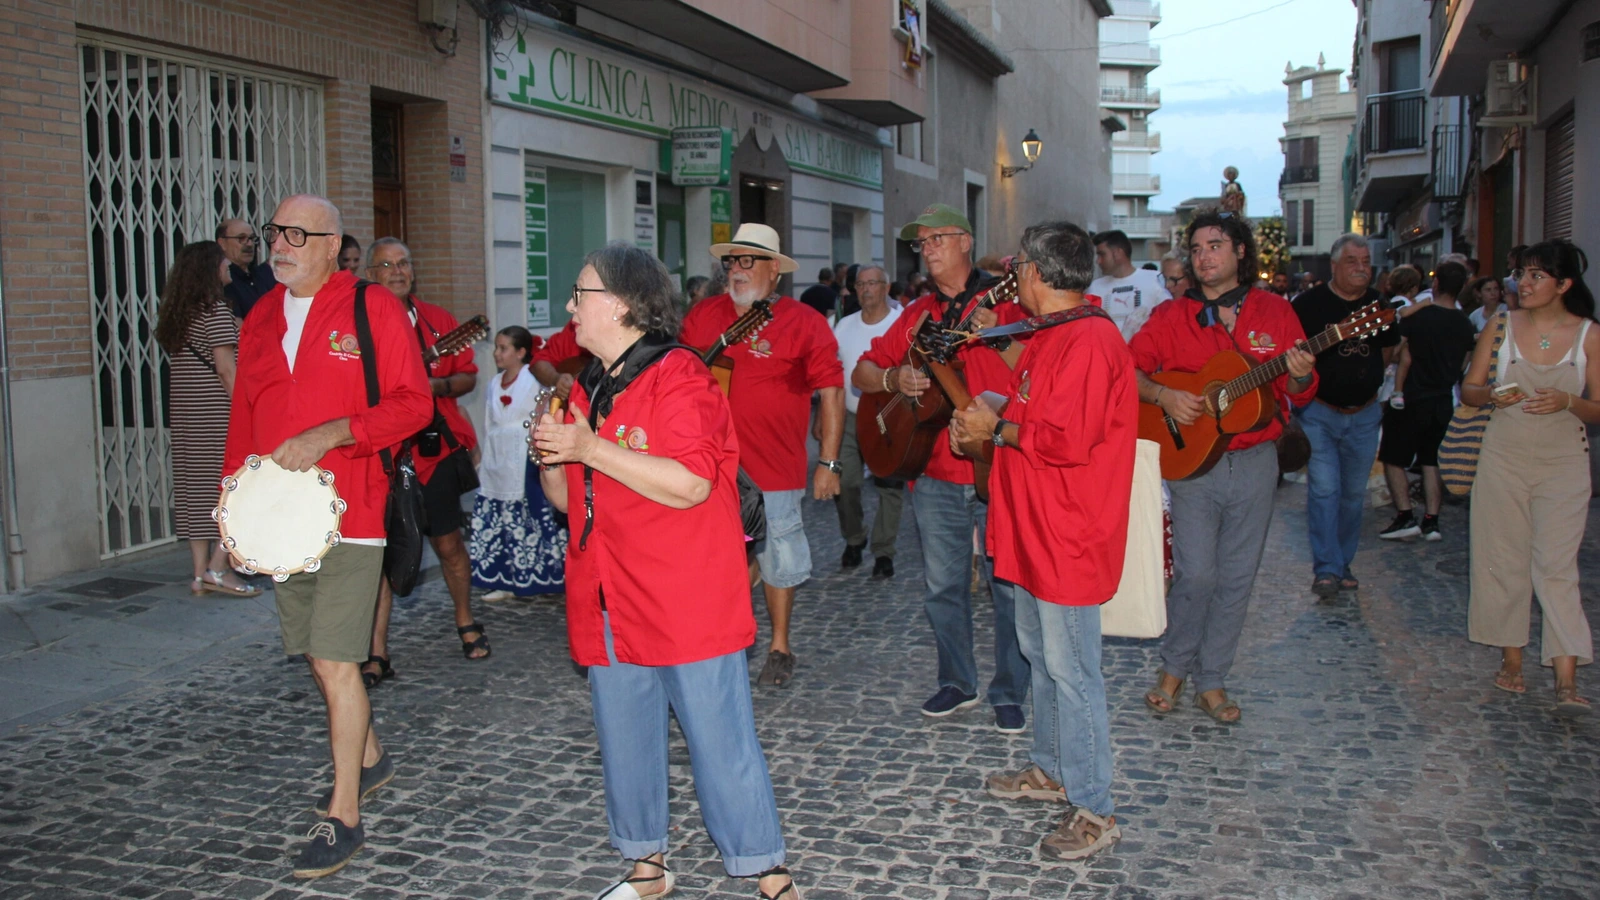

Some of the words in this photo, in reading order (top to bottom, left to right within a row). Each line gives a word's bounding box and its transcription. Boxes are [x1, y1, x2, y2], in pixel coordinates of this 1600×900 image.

[549, 47, 655, 122] CLINICA
[669, 82, 741, 148] MEDICA
[785, 123, 811, 162] SAN
[1112, 285, 1134, 294] PUMA
